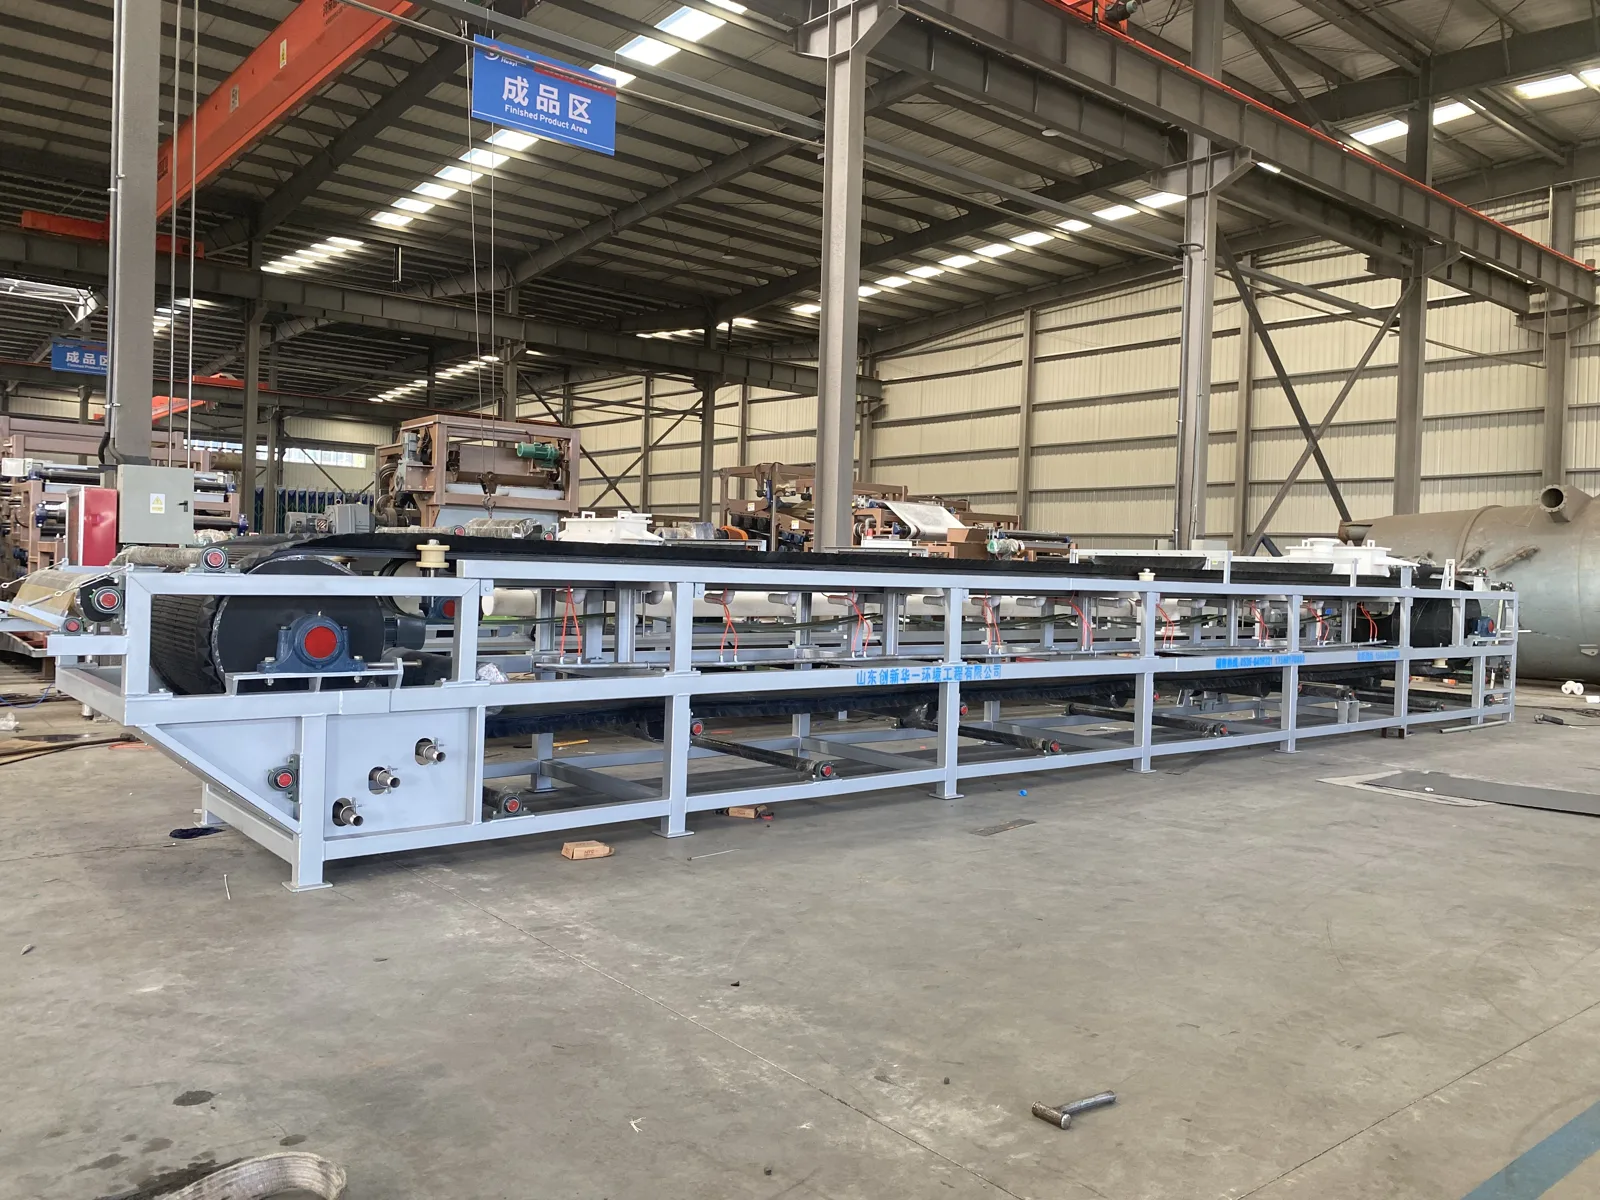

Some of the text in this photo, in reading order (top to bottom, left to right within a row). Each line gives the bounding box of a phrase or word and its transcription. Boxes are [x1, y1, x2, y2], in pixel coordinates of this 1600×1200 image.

[502, 76, 592, 124] 成品区
[504, 104, 588, 135] Finished Product Area
[856, 664, 1001, 685] 山东创新华一环境工程有限公司
